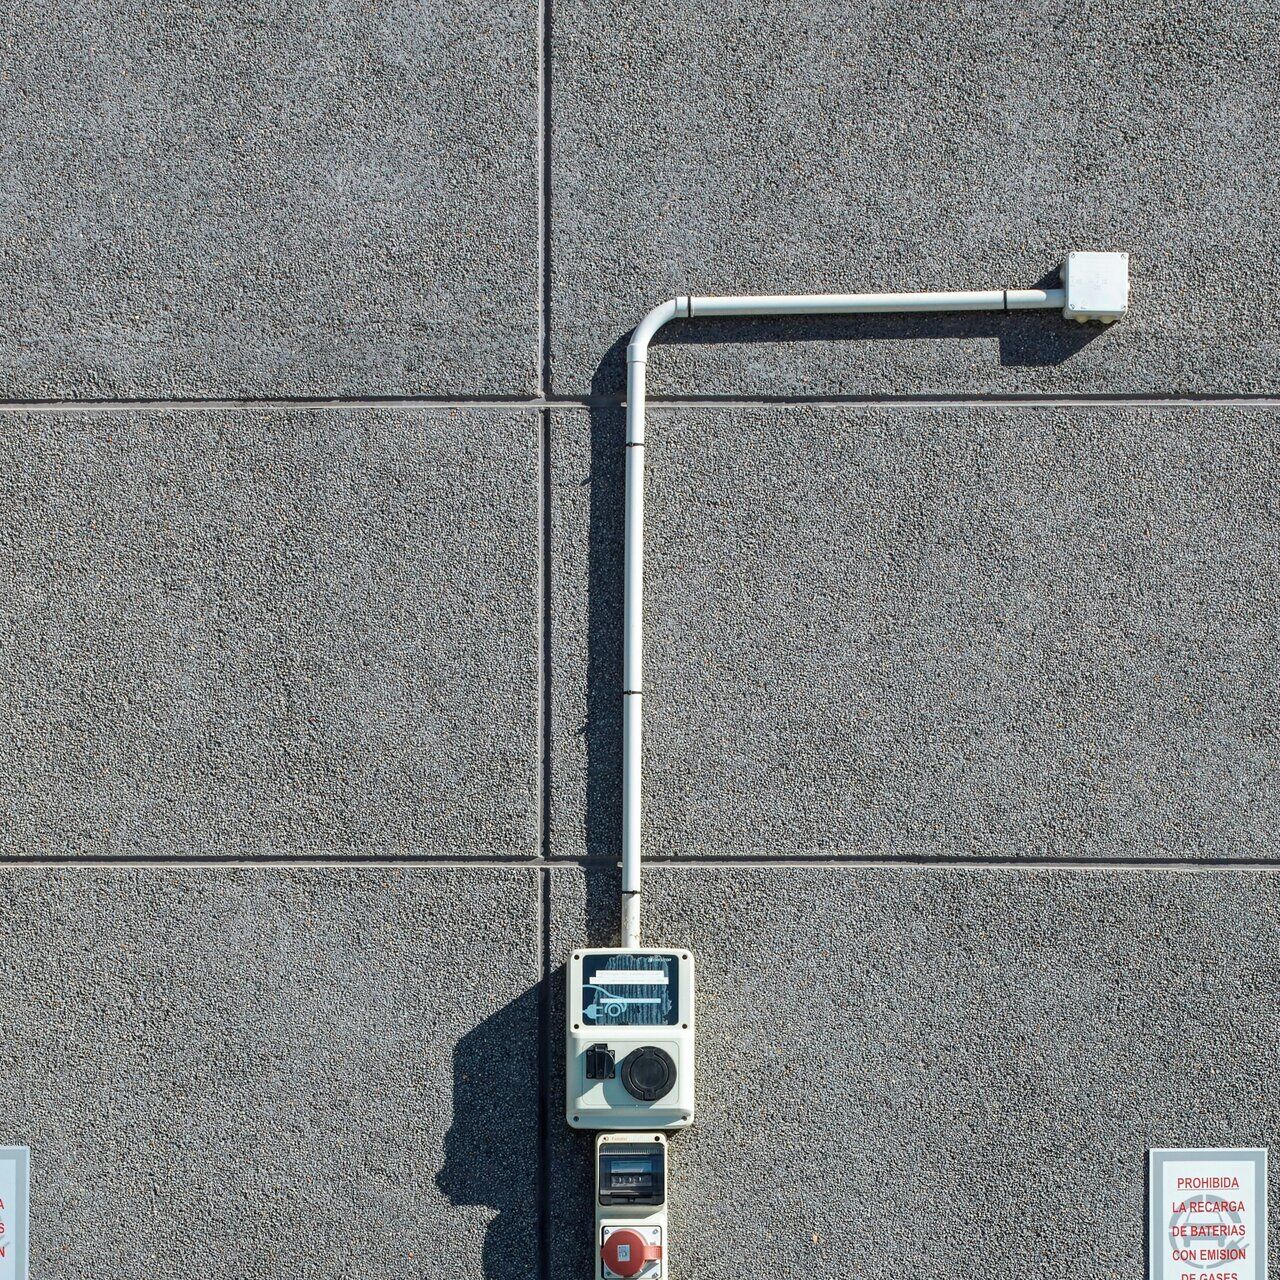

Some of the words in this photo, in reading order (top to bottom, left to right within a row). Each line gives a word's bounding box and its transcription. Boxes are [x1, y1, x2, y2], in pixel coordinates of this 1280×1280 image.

[1177, 1177, 1239, 1189] PROHIBIDA
[1172, 1201, 1187, 1213] LA
[1190, 1201, 1245, 1212] RECARGA
[1172, 1225, 1187, 1237] DE
[1190, 1225, 1246, 1236] BATERIAS
[1172, 1250, 1196, 1261] CON
[1200, 1249, 1246, 1260] EMISION
